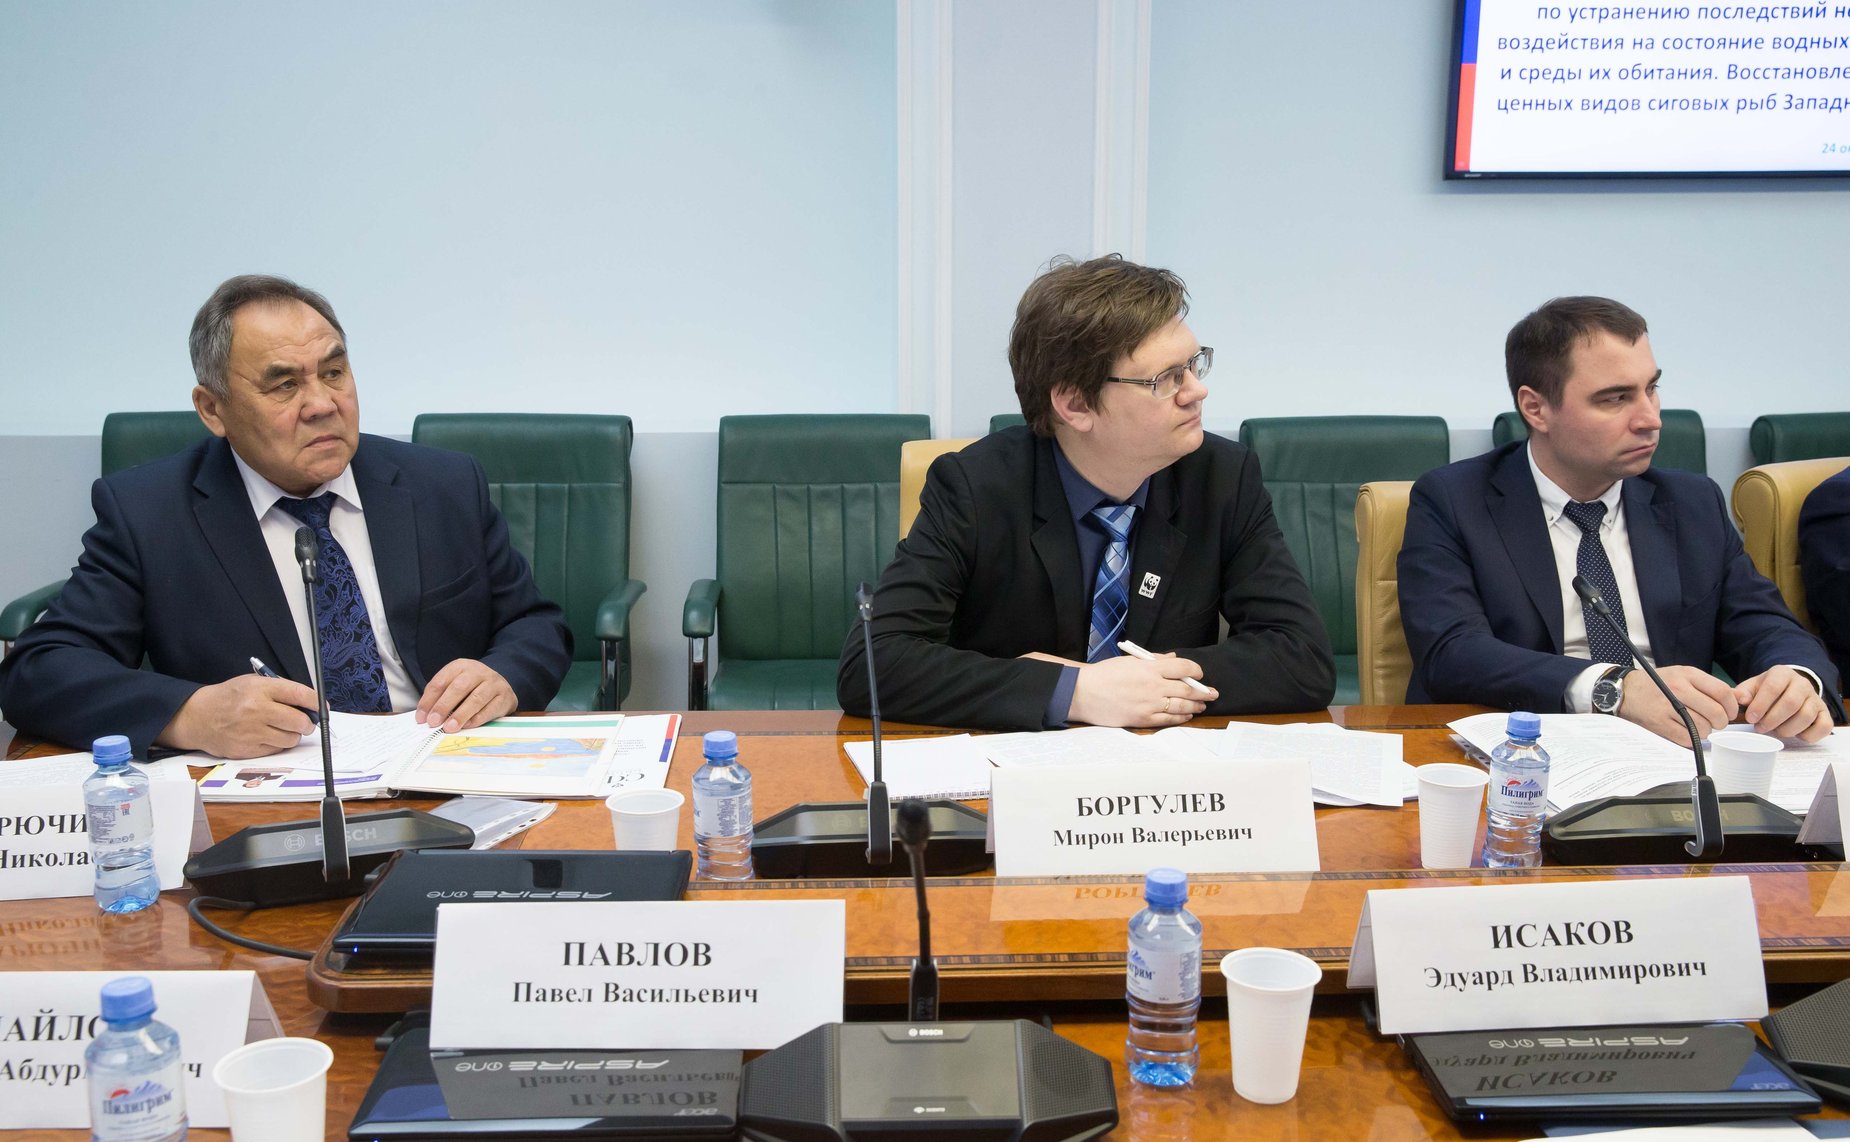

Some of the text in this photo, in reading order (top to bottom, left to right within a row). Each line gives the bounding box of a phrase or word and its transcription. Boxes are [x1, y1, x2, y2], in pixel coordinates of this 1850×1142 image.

[1537, 0, 1850, 23] по устранению последствий н
[1497, 33, 1849, 53] воздействия на состояние водных
[1500, 63, 1850, 84] и среды их обитания. Восстановле
[1497, 98, 1573, 114] ценных
[1580, 98, 1641, 113] видов
[1647, 98, 1729, 111] сиговых
[1736, 93, 1777, 114] рыб
[1821, 143, 1850, 154] 24 о
[1501, 785, 1544, 801] Пилигрим
[1077, 792, 1226, 817] БОРГУЛЕВ
[314, 827, 377, 847] BSCH
[1053, 827, 1252, 850] Мирон Валерьевич
[472, 890, 613, 899] ASPIRE
[1491, 920, 1634, 949] ИСАКОВ
[563, 941, 712, 967] ПАВЛОВ
[1424, 961, 1707, 992] Эдуард Владимирович
[513, 982, 758, 1003] Павел Васильевич
[1537, 1036, 1689, 1048] ASPIRE
[508, 1059, 670, 1071] ASPIRE
[103, 1090, 172, 1114] Пилигрим
